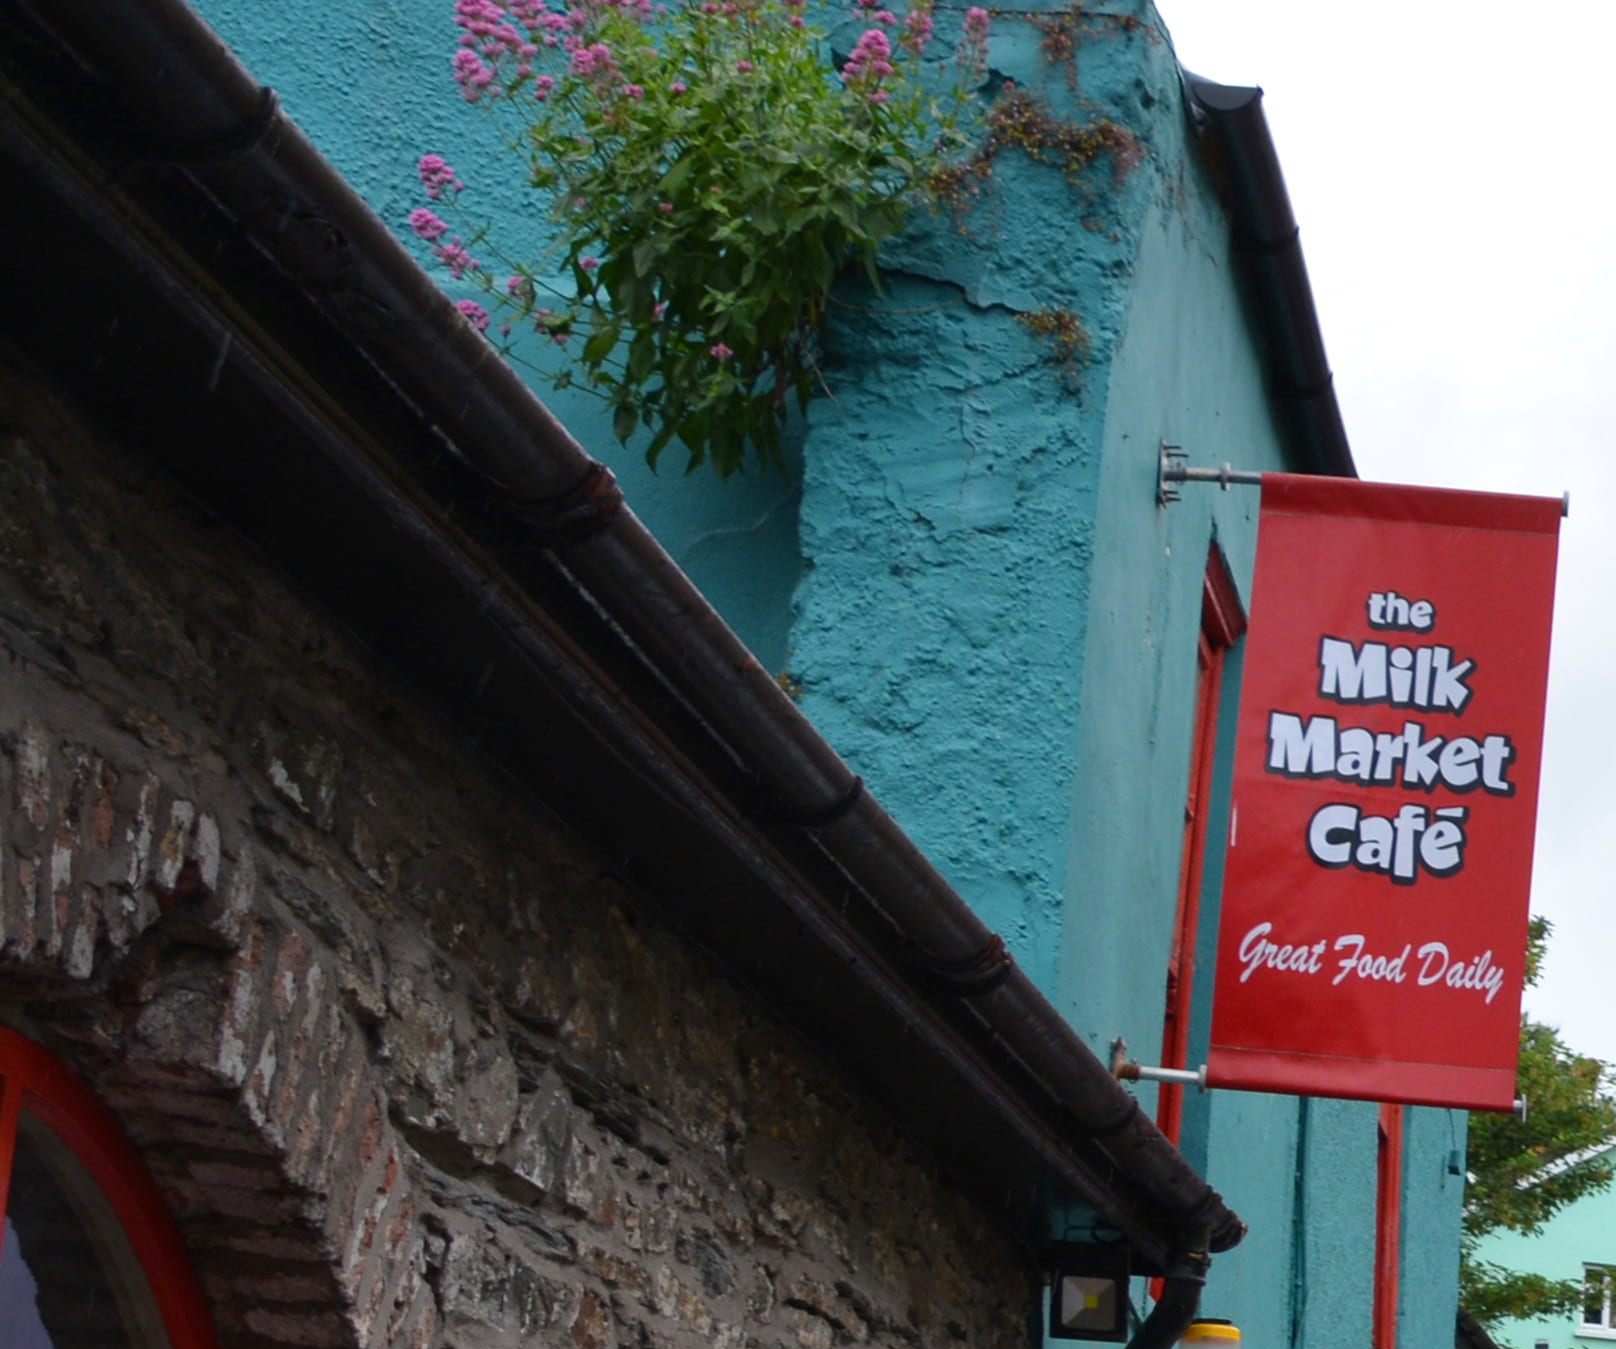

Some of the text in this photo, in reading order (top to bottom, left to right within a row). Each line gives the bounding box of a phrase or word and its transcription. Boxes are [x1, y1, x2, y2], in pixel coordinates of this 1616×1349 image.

[1367, 591, 1433, 629] the
[1319, 637, 1474, 709] Milk
[1268, 711, 1513, 792] Market
[1309, 803, 1466, 879] Café
[1238, 922, 1504, 1005] Great Food Daily
